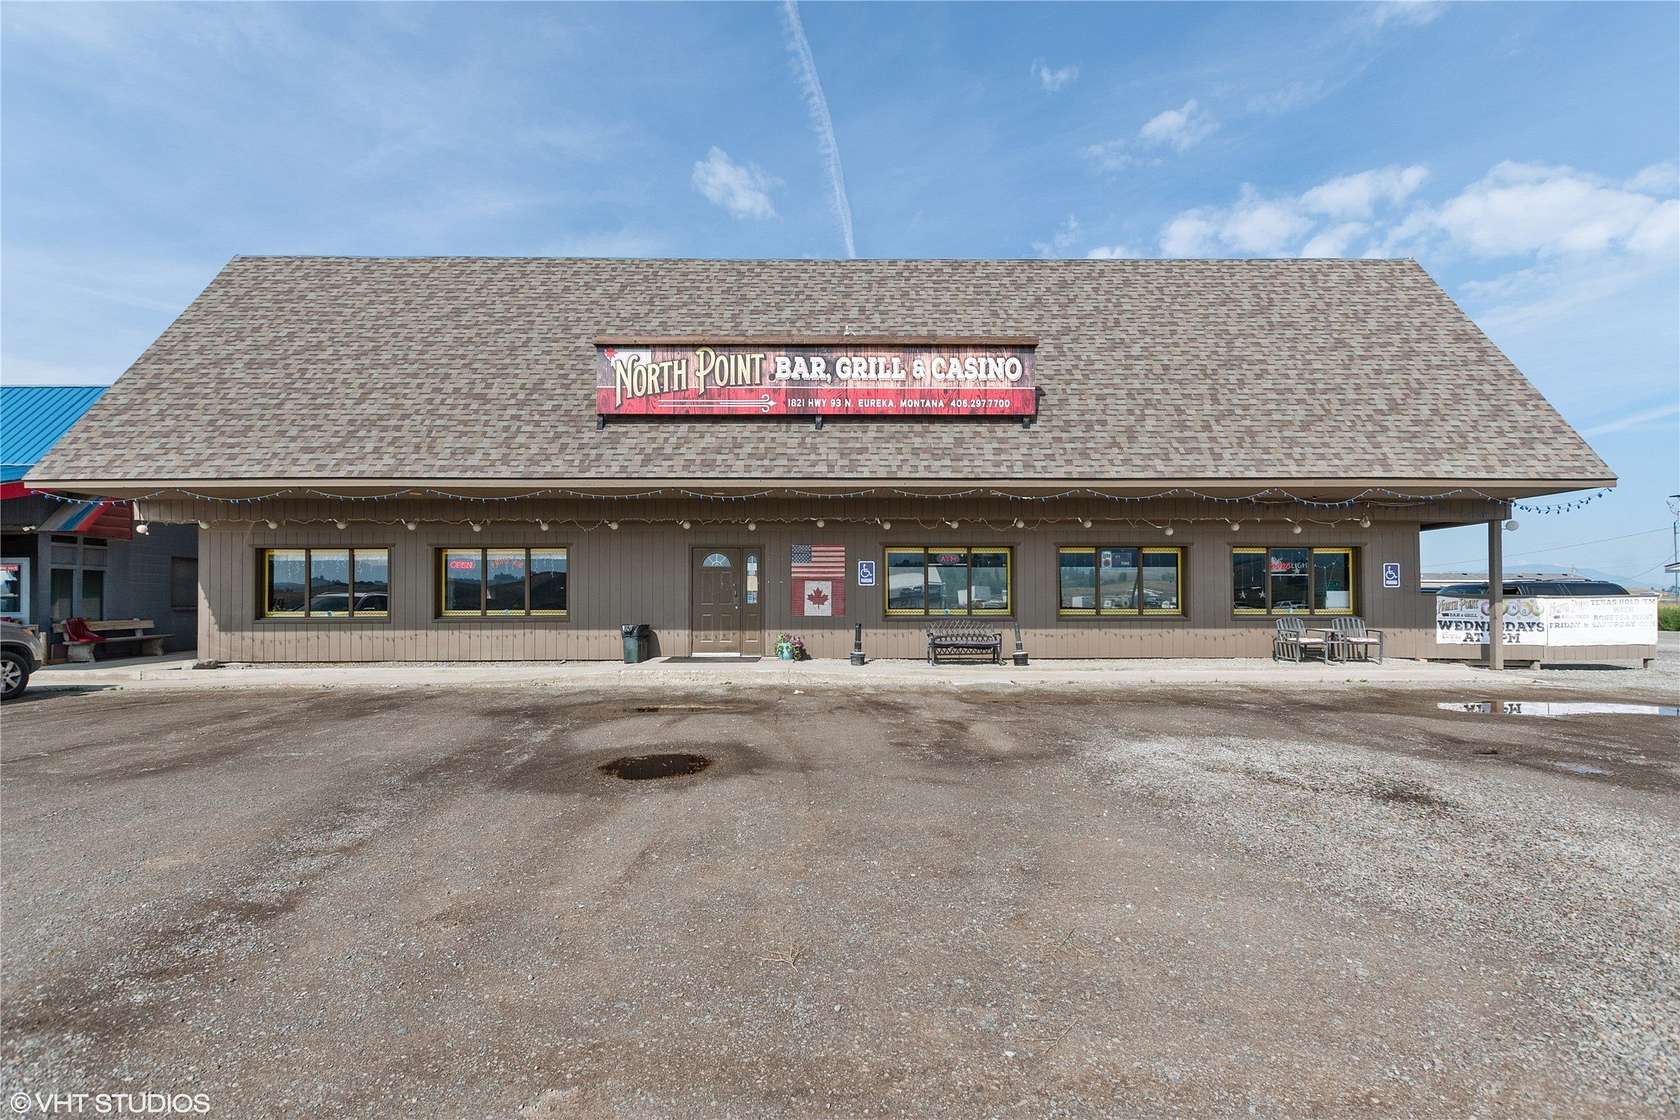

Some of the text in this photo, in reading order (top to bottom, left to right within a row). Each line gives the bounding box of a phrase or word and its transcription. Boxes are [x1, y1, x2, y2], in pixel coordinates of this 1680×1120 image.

[614, 346, 1023, 408] NORTH POINT BAR, GRILL & CASINO
[787, 398, 805, 408] 1821
[808, 399, 827, 408] HWY
[830, 399, 843, 408] 93
[900, 399, 945, 408] MONTANA
[950, 399, 1011, 408] 406.297.7700
[449, 560, 474, 569] OPEN
[1437, 620, 1545, 632] WEDNDAYS
[1463, 632, 1484, 642] AT
